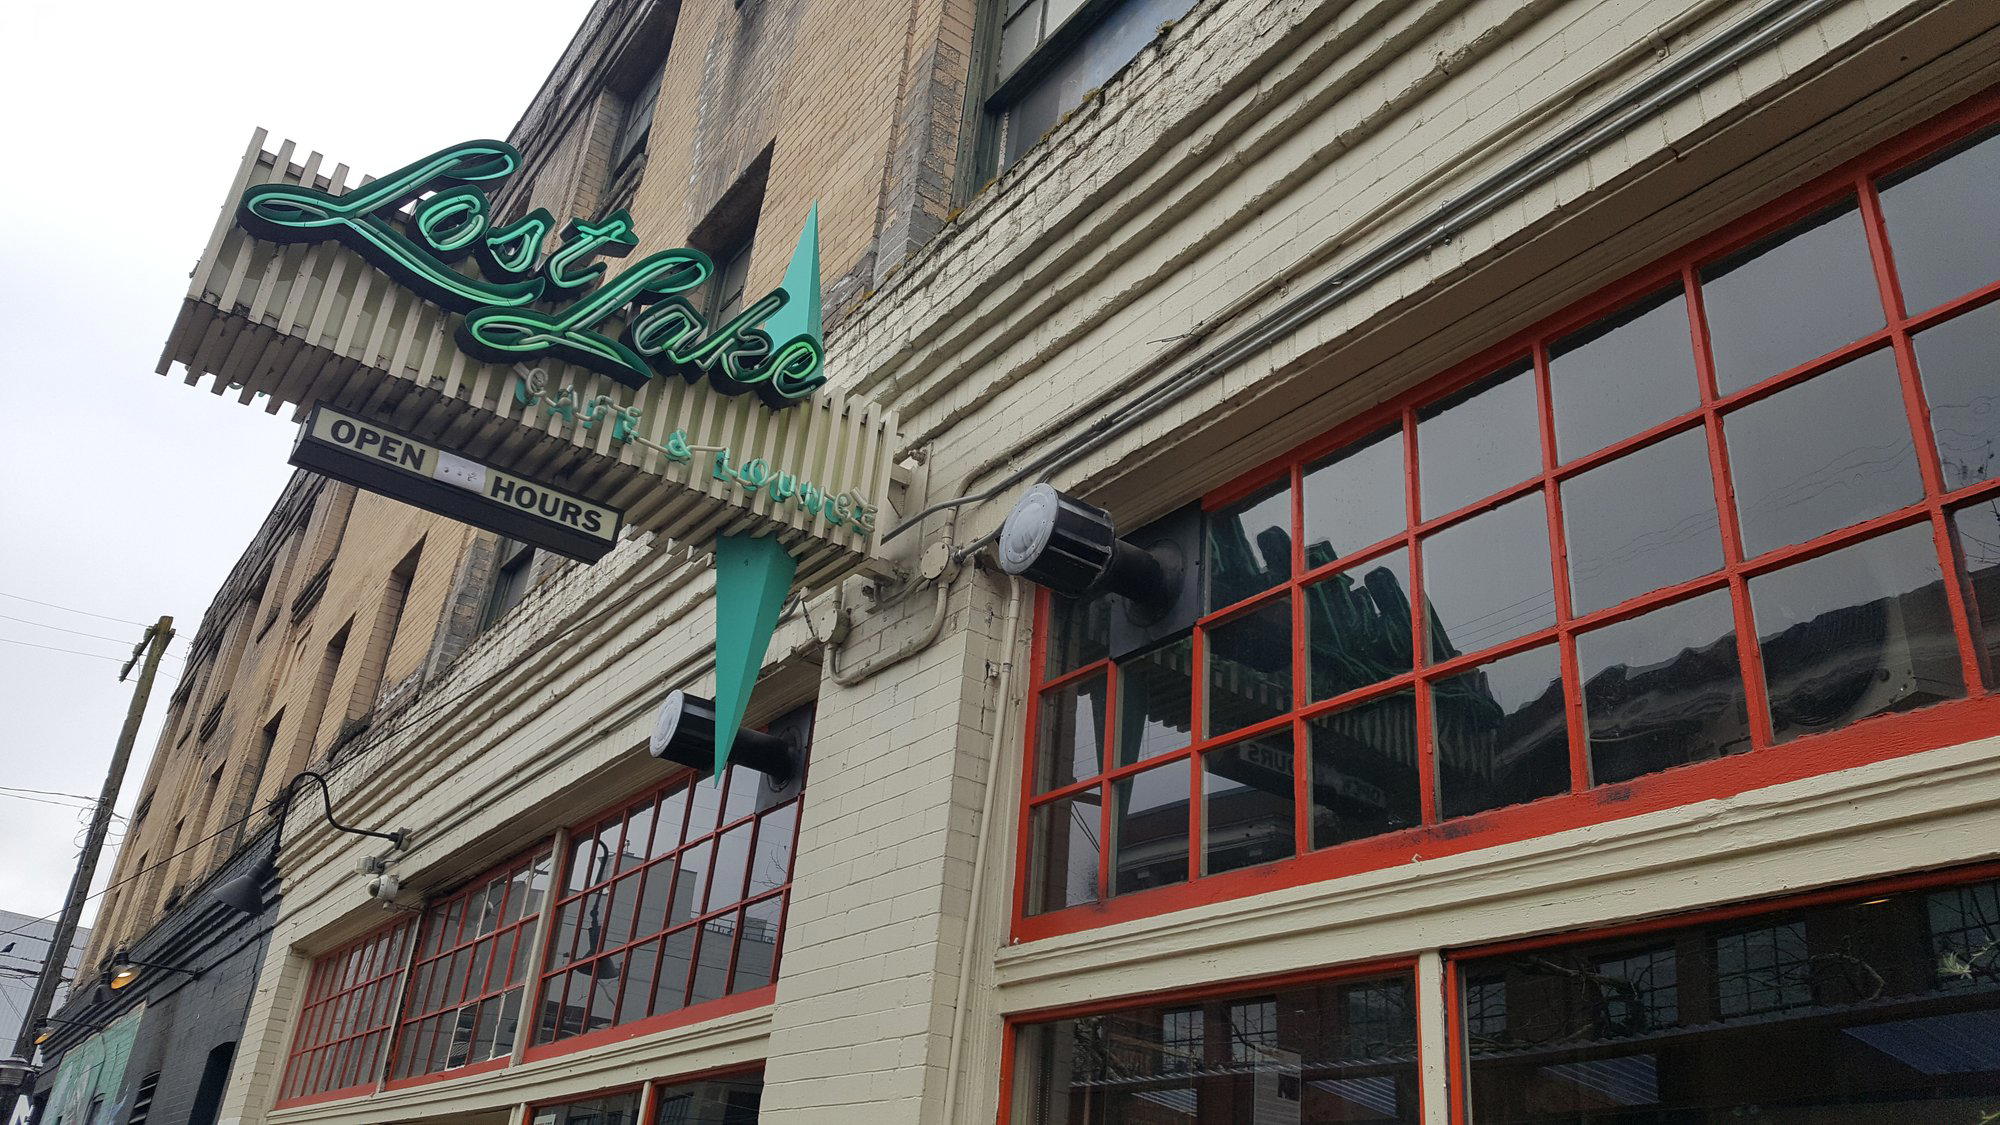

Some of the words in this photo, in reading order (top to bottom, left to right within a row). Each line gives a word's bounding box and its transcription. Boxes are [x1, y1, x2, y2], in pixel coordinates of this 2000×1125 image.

[238, 138, 639, 309] Lost
[460, 246, 827, 402] Lake
[330, 419, 425, 471] OPEN
[490, 475, 601, 533] HOURS
[514, 366, 643, 442] CAFE
[662, 428, 692, 466] &
[713, 447, 878, 537] LOUNGE
